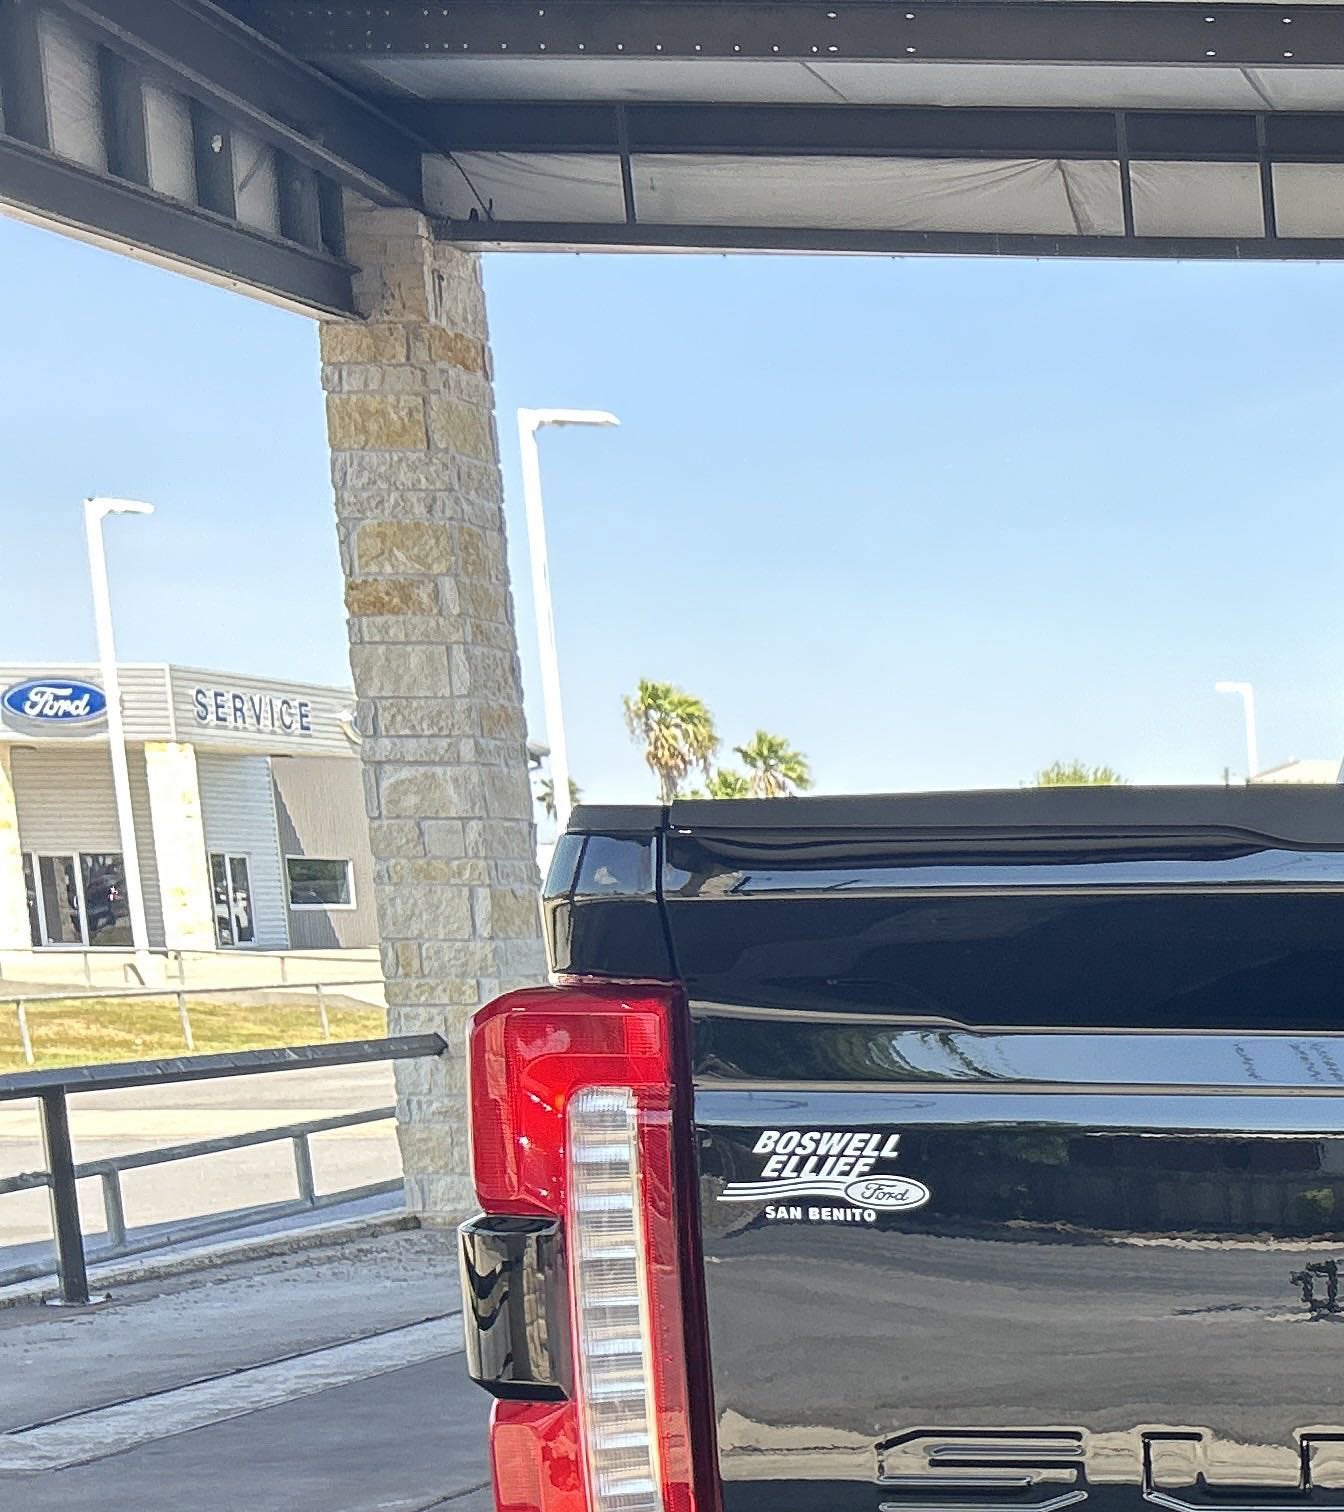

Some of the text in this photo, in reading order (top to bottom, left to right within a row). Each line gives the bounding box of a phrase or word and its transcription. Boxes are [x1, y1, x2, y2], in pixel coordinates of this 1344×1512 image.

[24, 686, 90, 716] Ford
[194, 687, 312, 732] SERVICE
[752, 1130, 901, 1158] BOSWELL
[761, 1155, 876, 1178] ELLIFF
[861, 1182, 910, 1202] Ford
[765, 1205, 877, 1222] SAN BENITO
